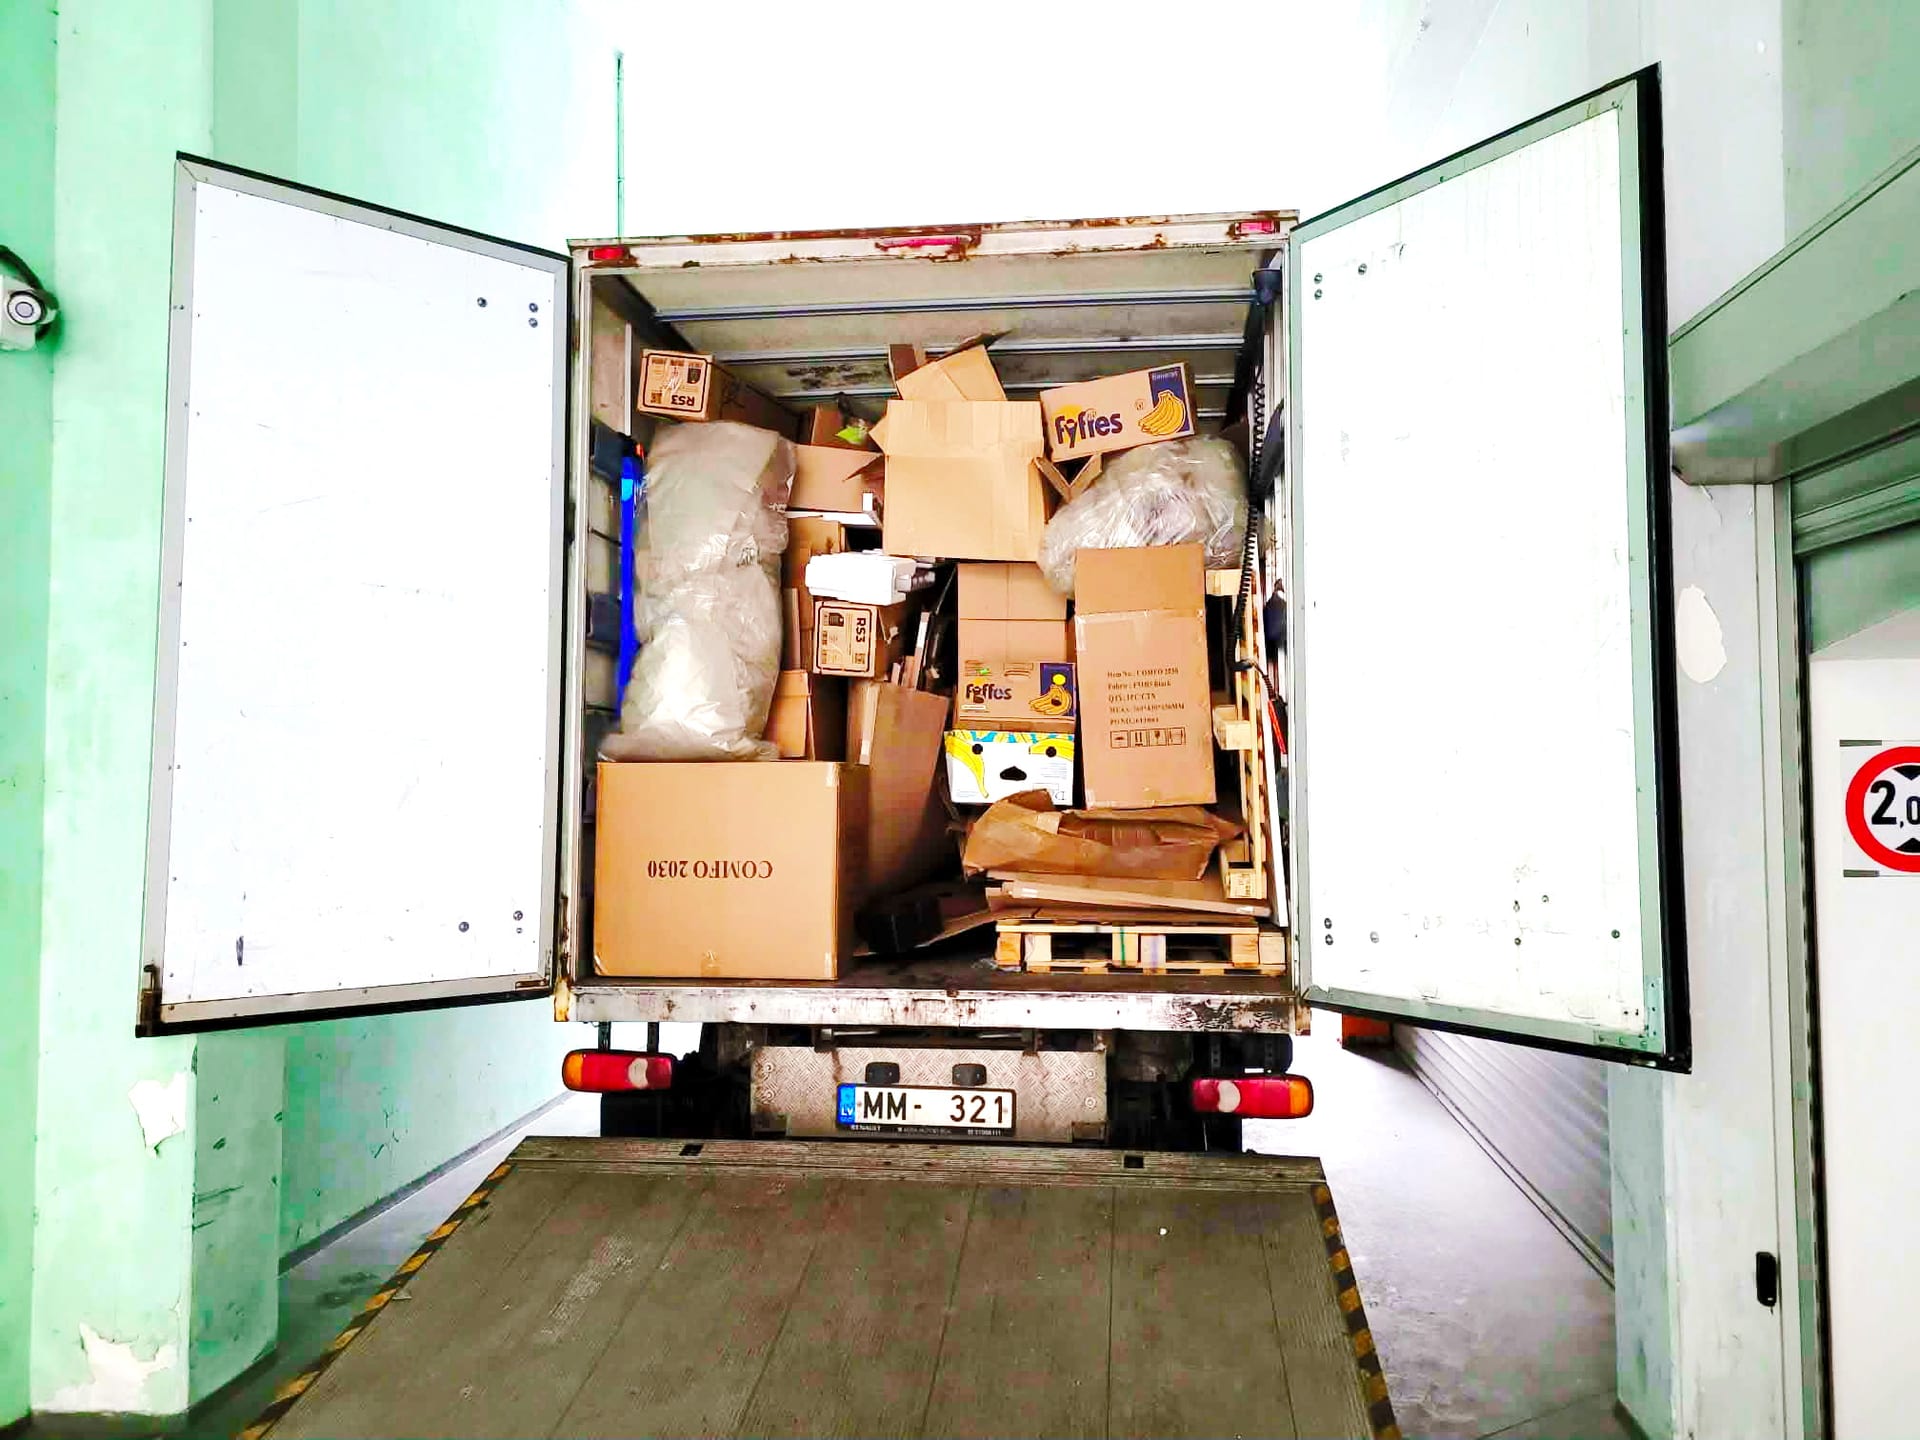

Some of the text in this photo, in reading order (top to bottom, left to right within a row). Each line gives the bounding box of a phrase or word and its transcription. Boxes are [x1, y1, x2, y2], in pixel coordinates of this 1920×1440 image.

[671, 394, 695, 407] RS3
[855, 617, 866, 643] RS3
[1870, 780, 1920, 828] 2,0
[647, 860, 773, 879] COMFO 2030
[949, 1094, 1003, 1124] 321
